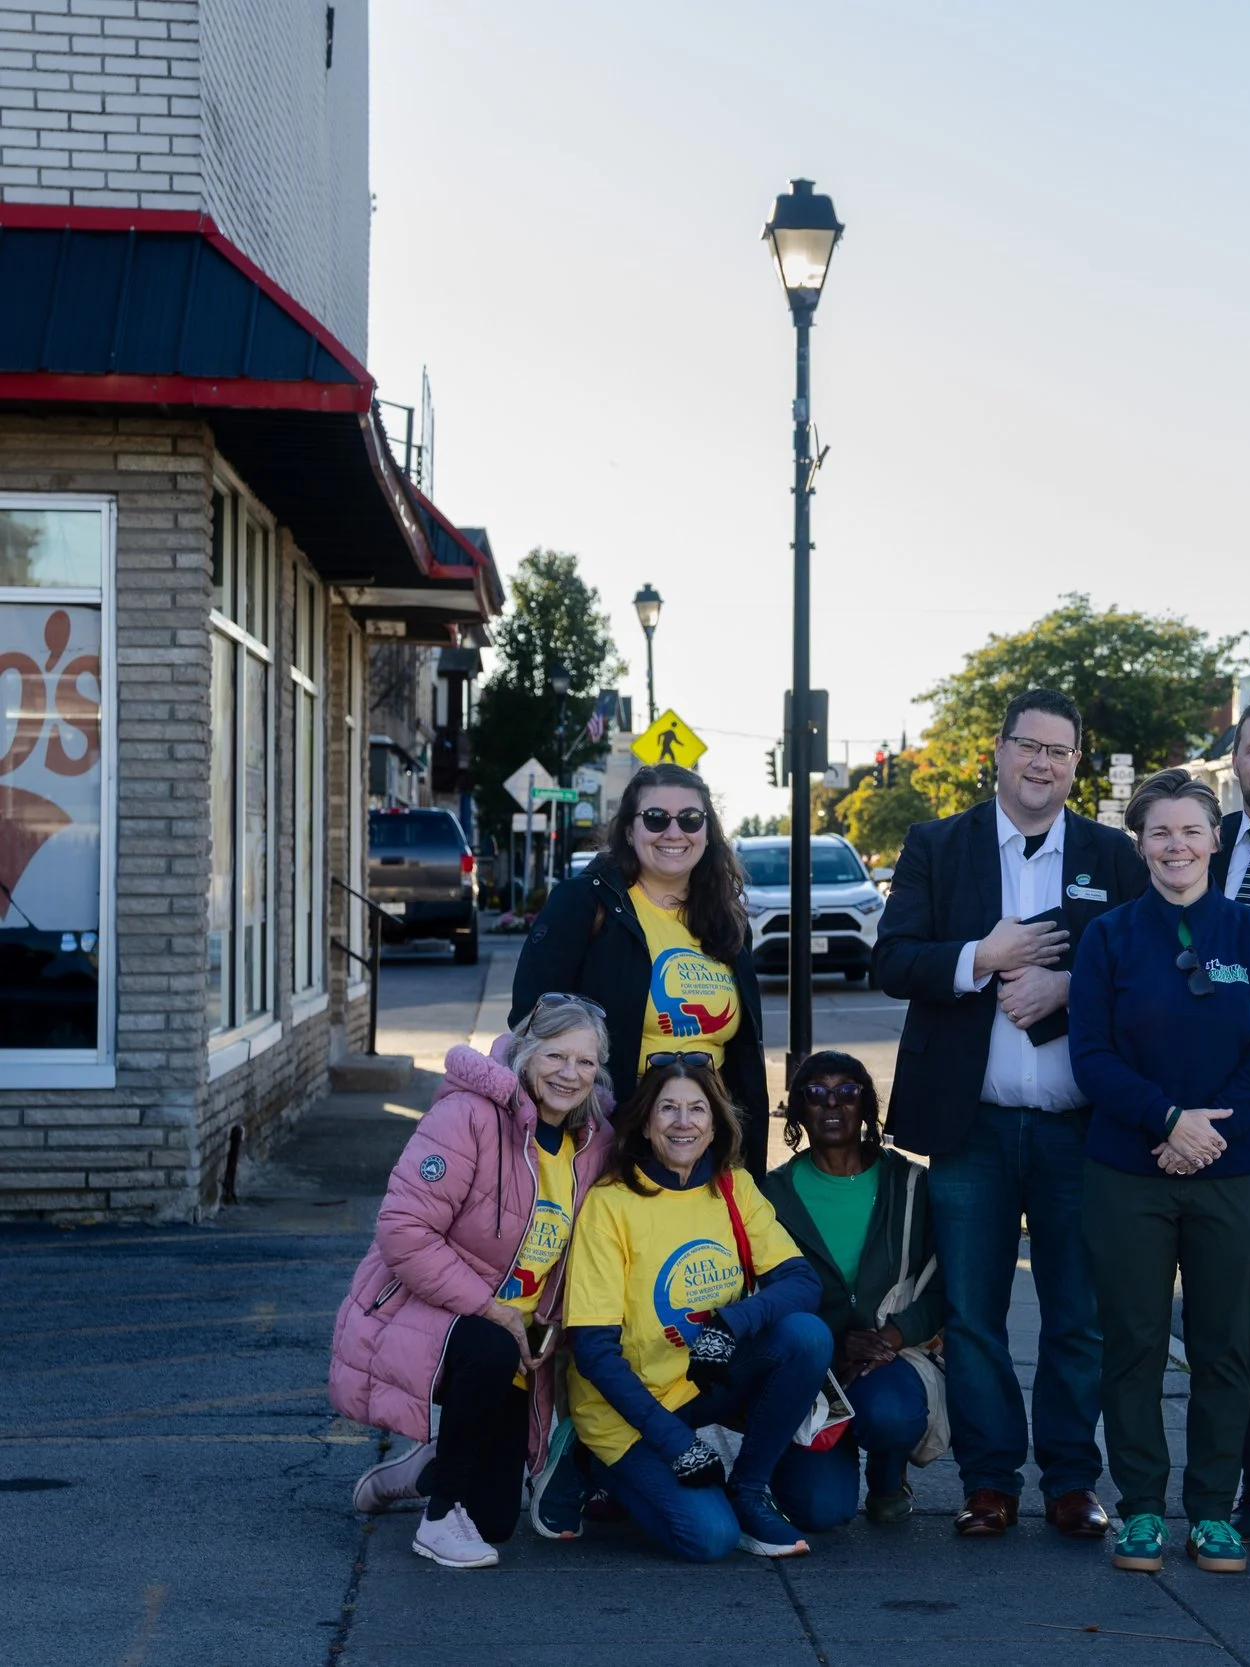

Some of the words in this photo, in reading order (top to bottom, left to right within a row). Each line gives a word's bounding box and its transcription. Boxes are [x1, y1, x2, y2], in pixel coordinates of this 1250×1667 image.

[677, 962, 708, 971] ALEX
[532, 1220, 560, 1236] LEX
[683, 1258, 716, 1276] ALEX
[699, 1283, 724, 1294] WEBSTER
[687, 1291, 720, 1304] SUPERVISOR
